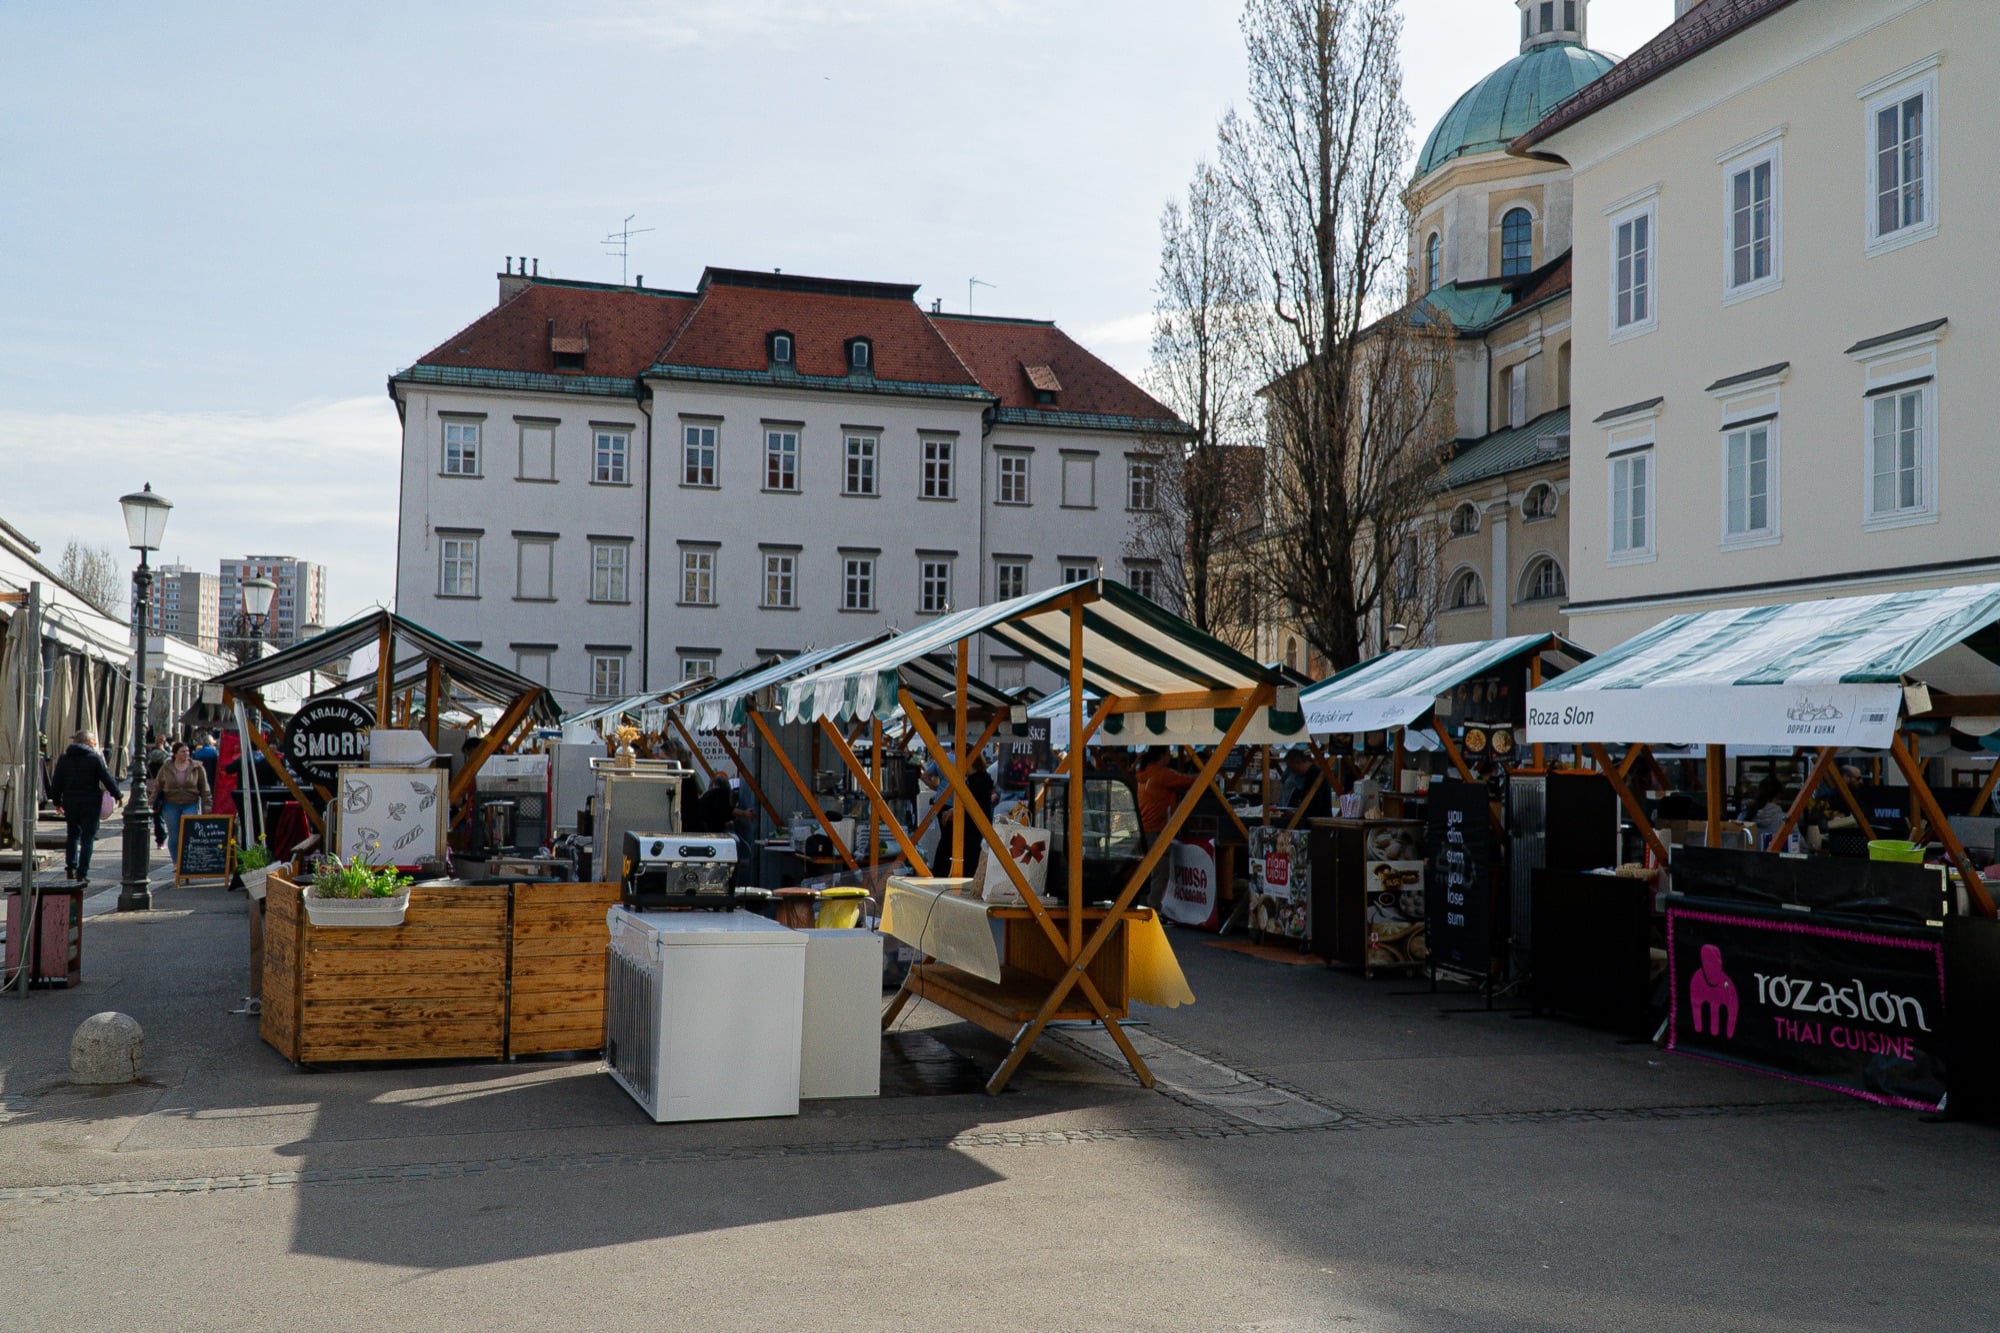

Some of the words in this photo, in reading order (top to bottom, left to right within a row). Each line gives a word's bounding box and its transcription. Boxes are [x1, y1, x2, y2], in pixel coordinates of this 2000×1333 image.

[310, 706, 349, 721] KRALJU
[349, 712, 364, 727] PO
[1528, 707, 1559, 726] Roza
[1563, 706, 1594, 726] Slon
[1011, 741, 1034, 755] PITE
[1447, 809, 1463, 827] you
[1873, 807, 1902, 819] WINE
[1446, 826, 1464, 844] dim
[1446, 849, 1465, 865] sum
[1174, 864, 1208, 889] PINSA
[1447, 871, 1464, 887] you
[1447, 890, 1464, 907] lose
[1447, 911, 1465, 927] sum
[1753, 971, 1933, 1033] rozaslon
[1773, 1016, 1823, 1046] THAI
[1829, 1025, 1916, 1062] CUISINE
